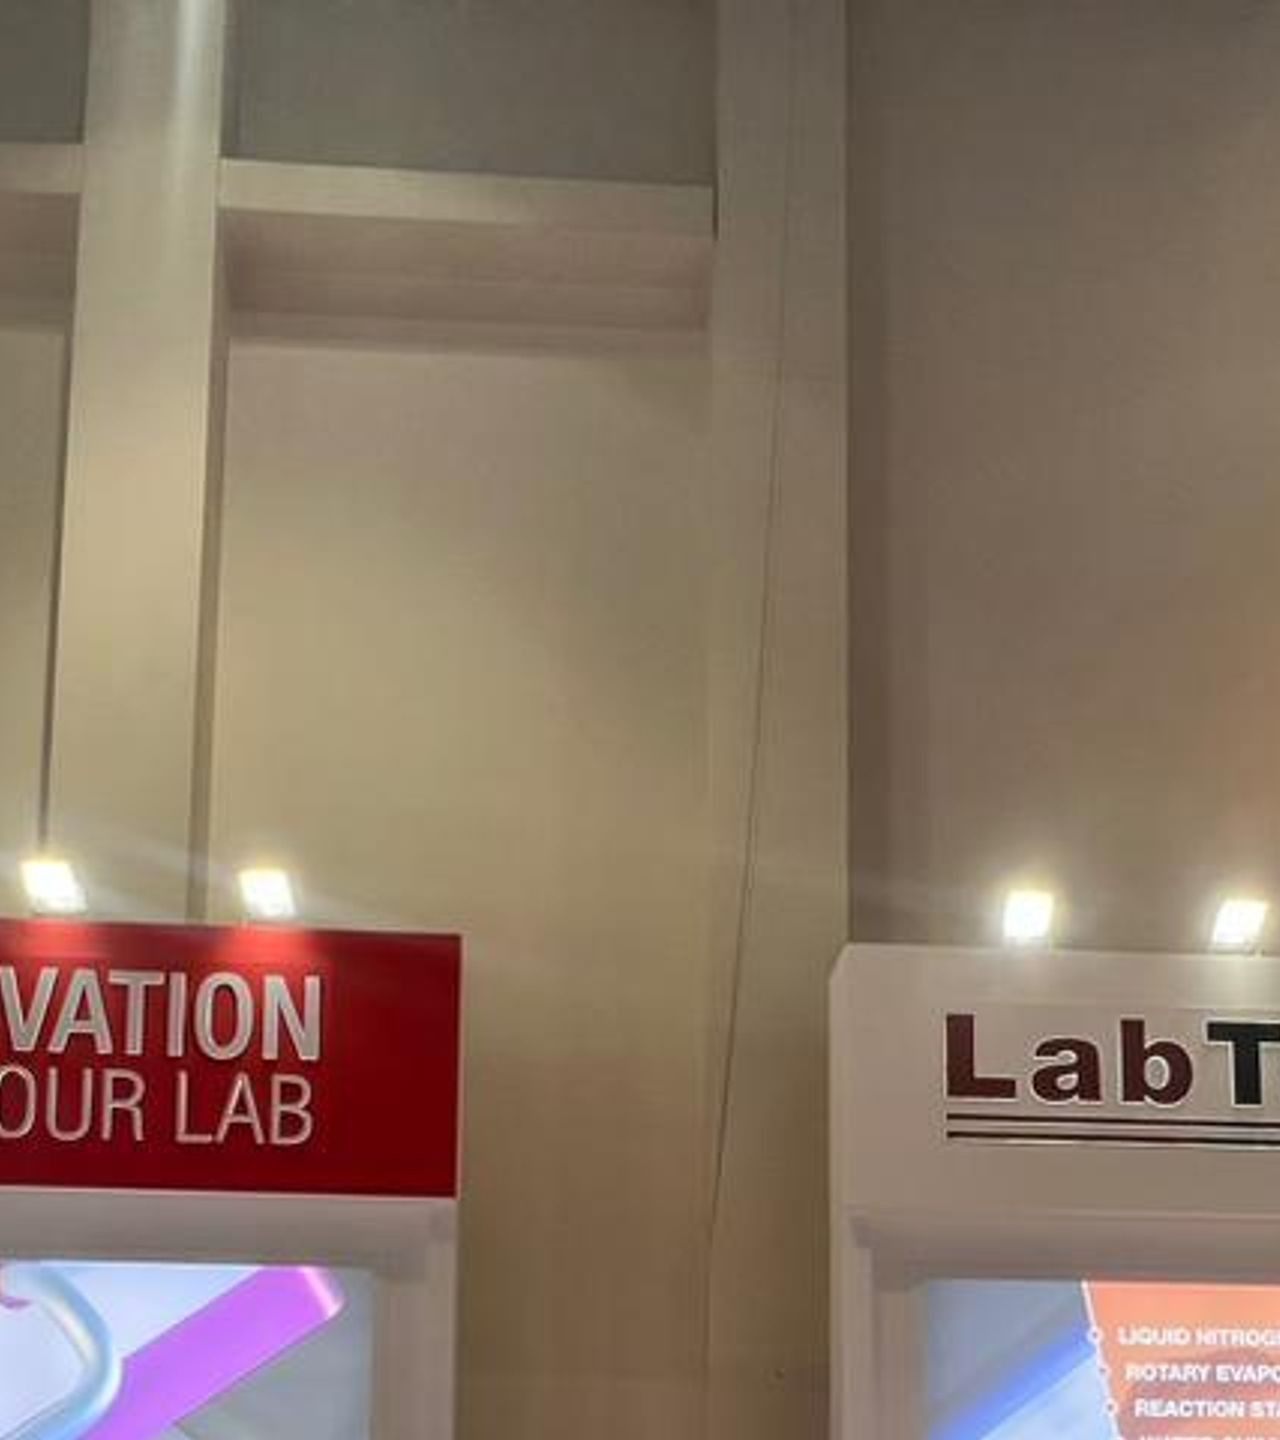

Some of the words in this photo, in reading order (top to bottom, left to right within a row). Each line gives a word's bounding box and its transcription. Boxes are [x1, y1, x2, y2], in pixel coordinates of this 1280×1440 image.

[174, 1071, 314, 1147] LAB
[1118, 1328, 1190, 1348] LIQUID
[1125, 1364, 1209, 1383] ROTARY
[1134, 1400, 1244, 1418] REACTION
